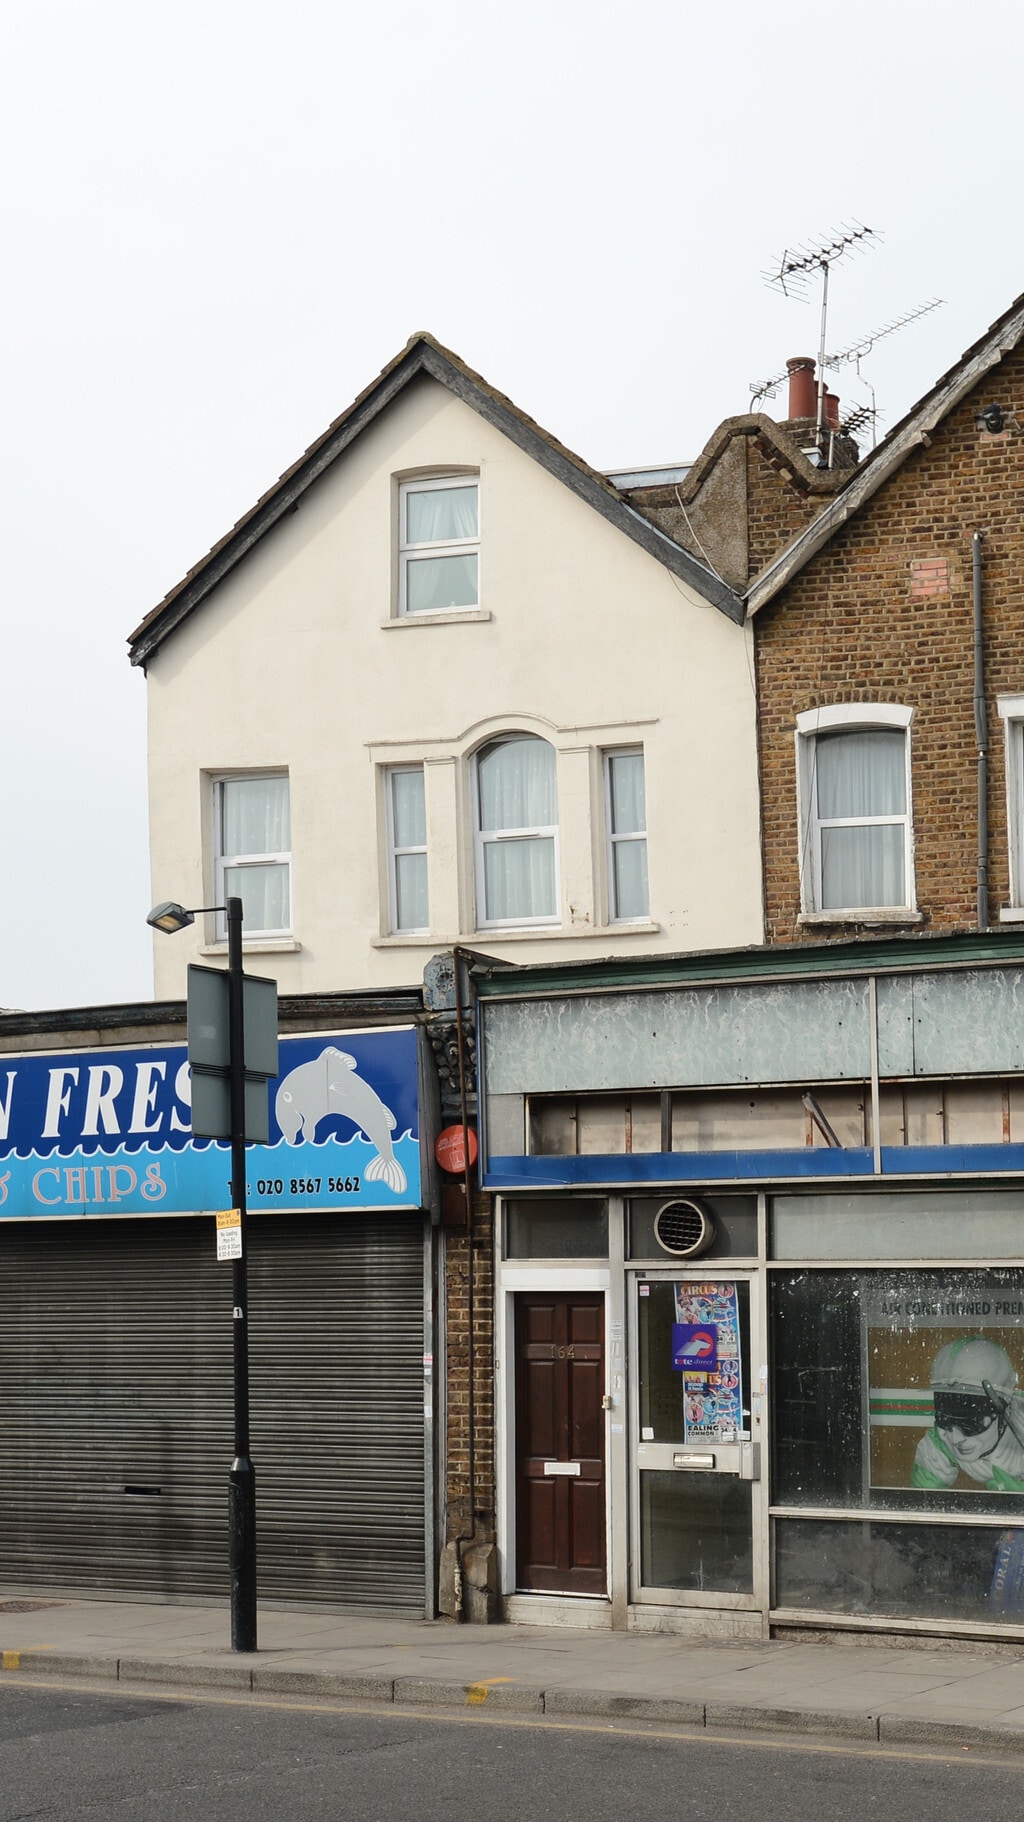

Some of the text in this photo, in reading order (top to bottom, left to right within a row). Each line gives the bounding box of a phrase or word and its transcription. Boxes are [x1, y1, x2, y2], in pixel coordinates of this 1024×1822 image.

[40, 1060, 193, 1138] FRES
[32, 1161, 167, 1205] CHIPS
[256, 1179, 284, 1195] 020
[290, 1178, 321, 1194] 8567
[328, 1177, 360, 1192] 5662
[680, 1284, 718, 1295] CIRCUS
[551, 1345, 575, 1359] 164
